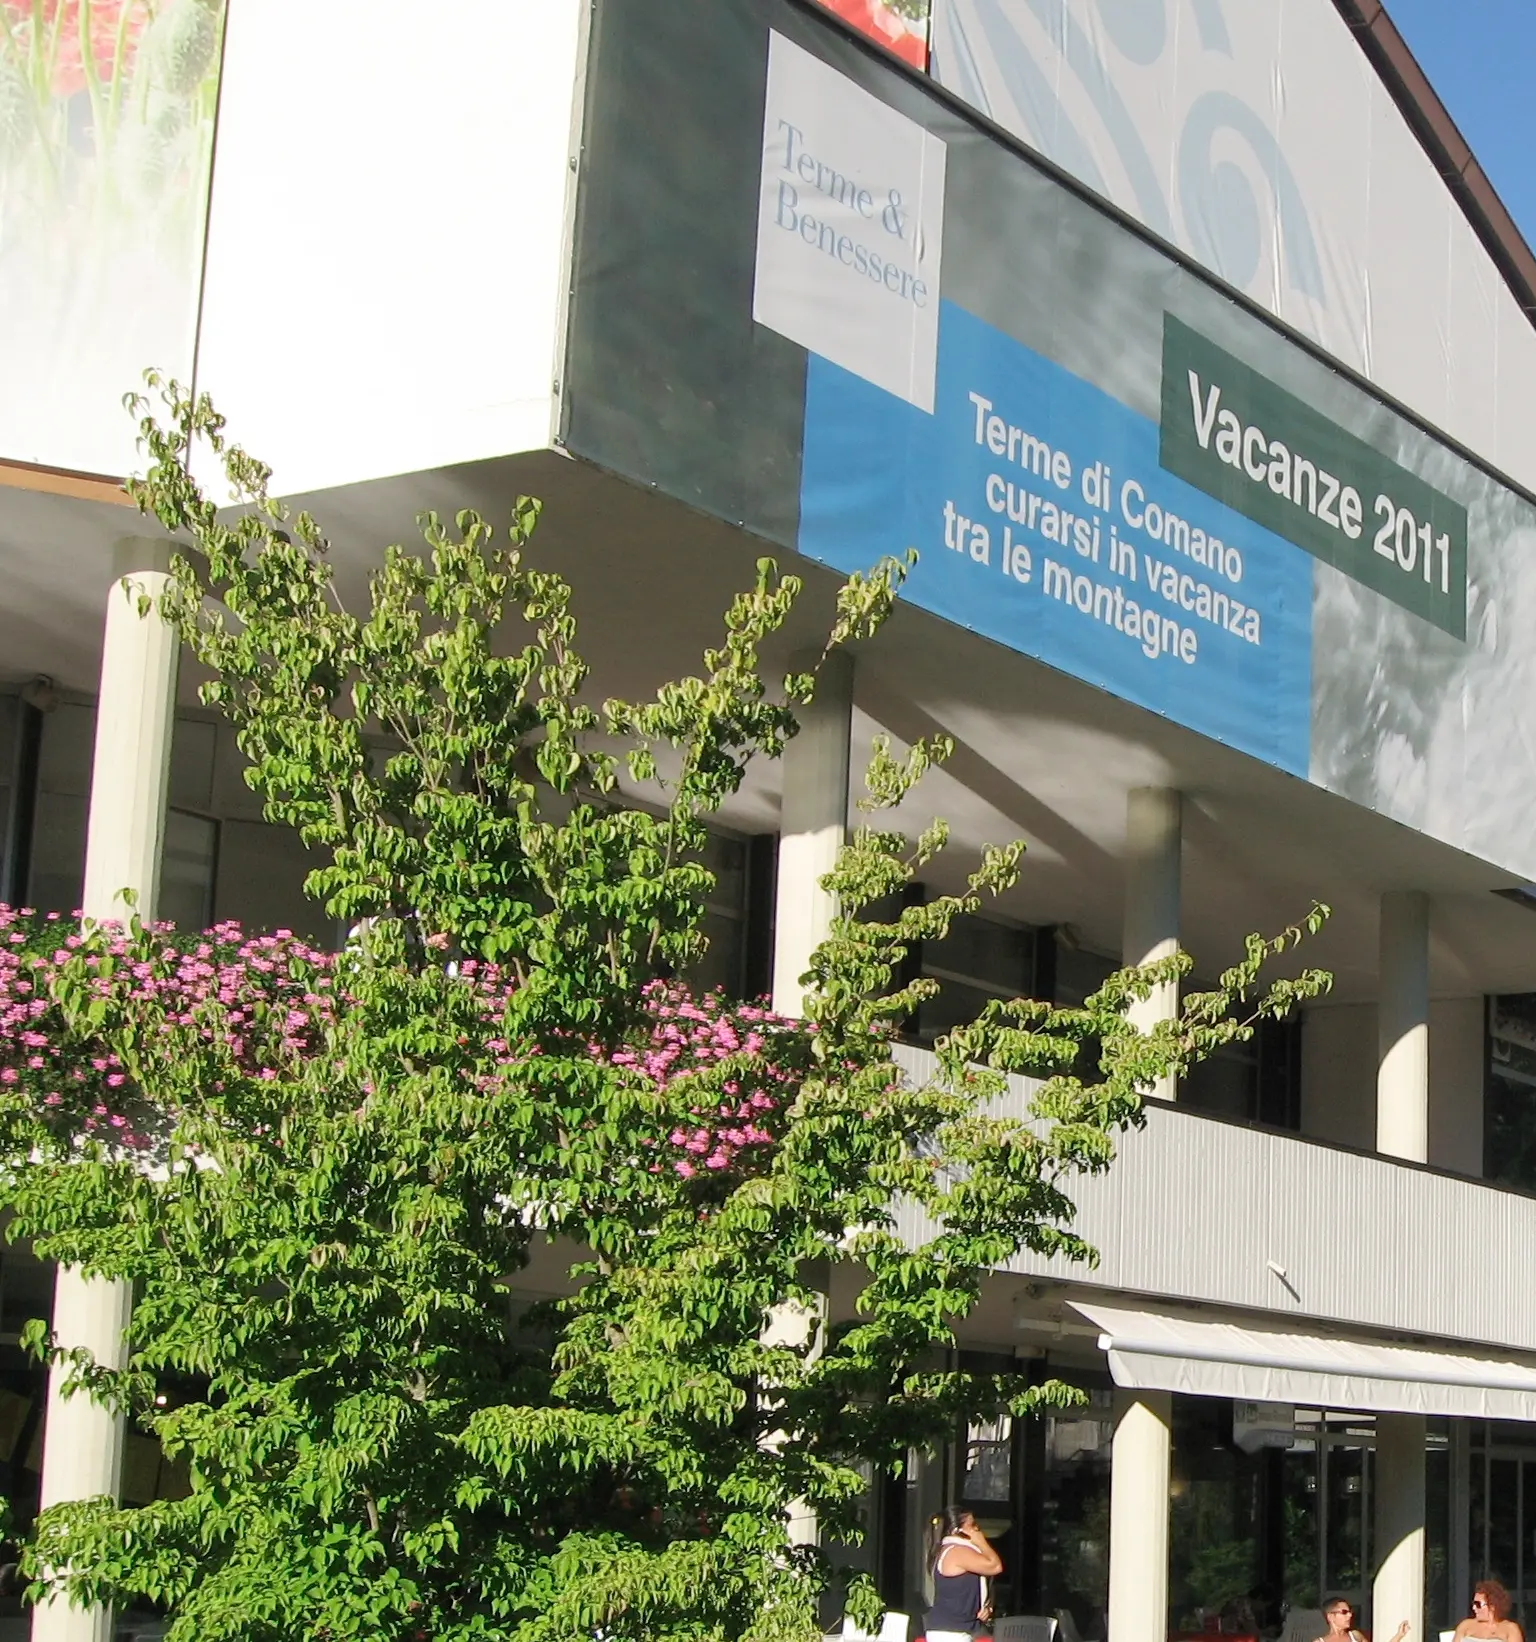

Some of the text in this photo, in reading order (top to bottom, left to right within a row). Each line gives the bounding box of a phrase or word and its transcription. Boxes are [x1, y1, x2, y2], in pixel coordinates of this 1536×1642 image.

[774, 179, 928, 308] Benessere
[777, 118, 910, 241] Terme &
[968, 390, 1243, 584] Terme di Comano
[985, 473, 1261, 646] curarsi in vacanza
[1186, 369, 1451, 594] Vacanze 2011
[943, 499, 1198, 665] tra le montagne
